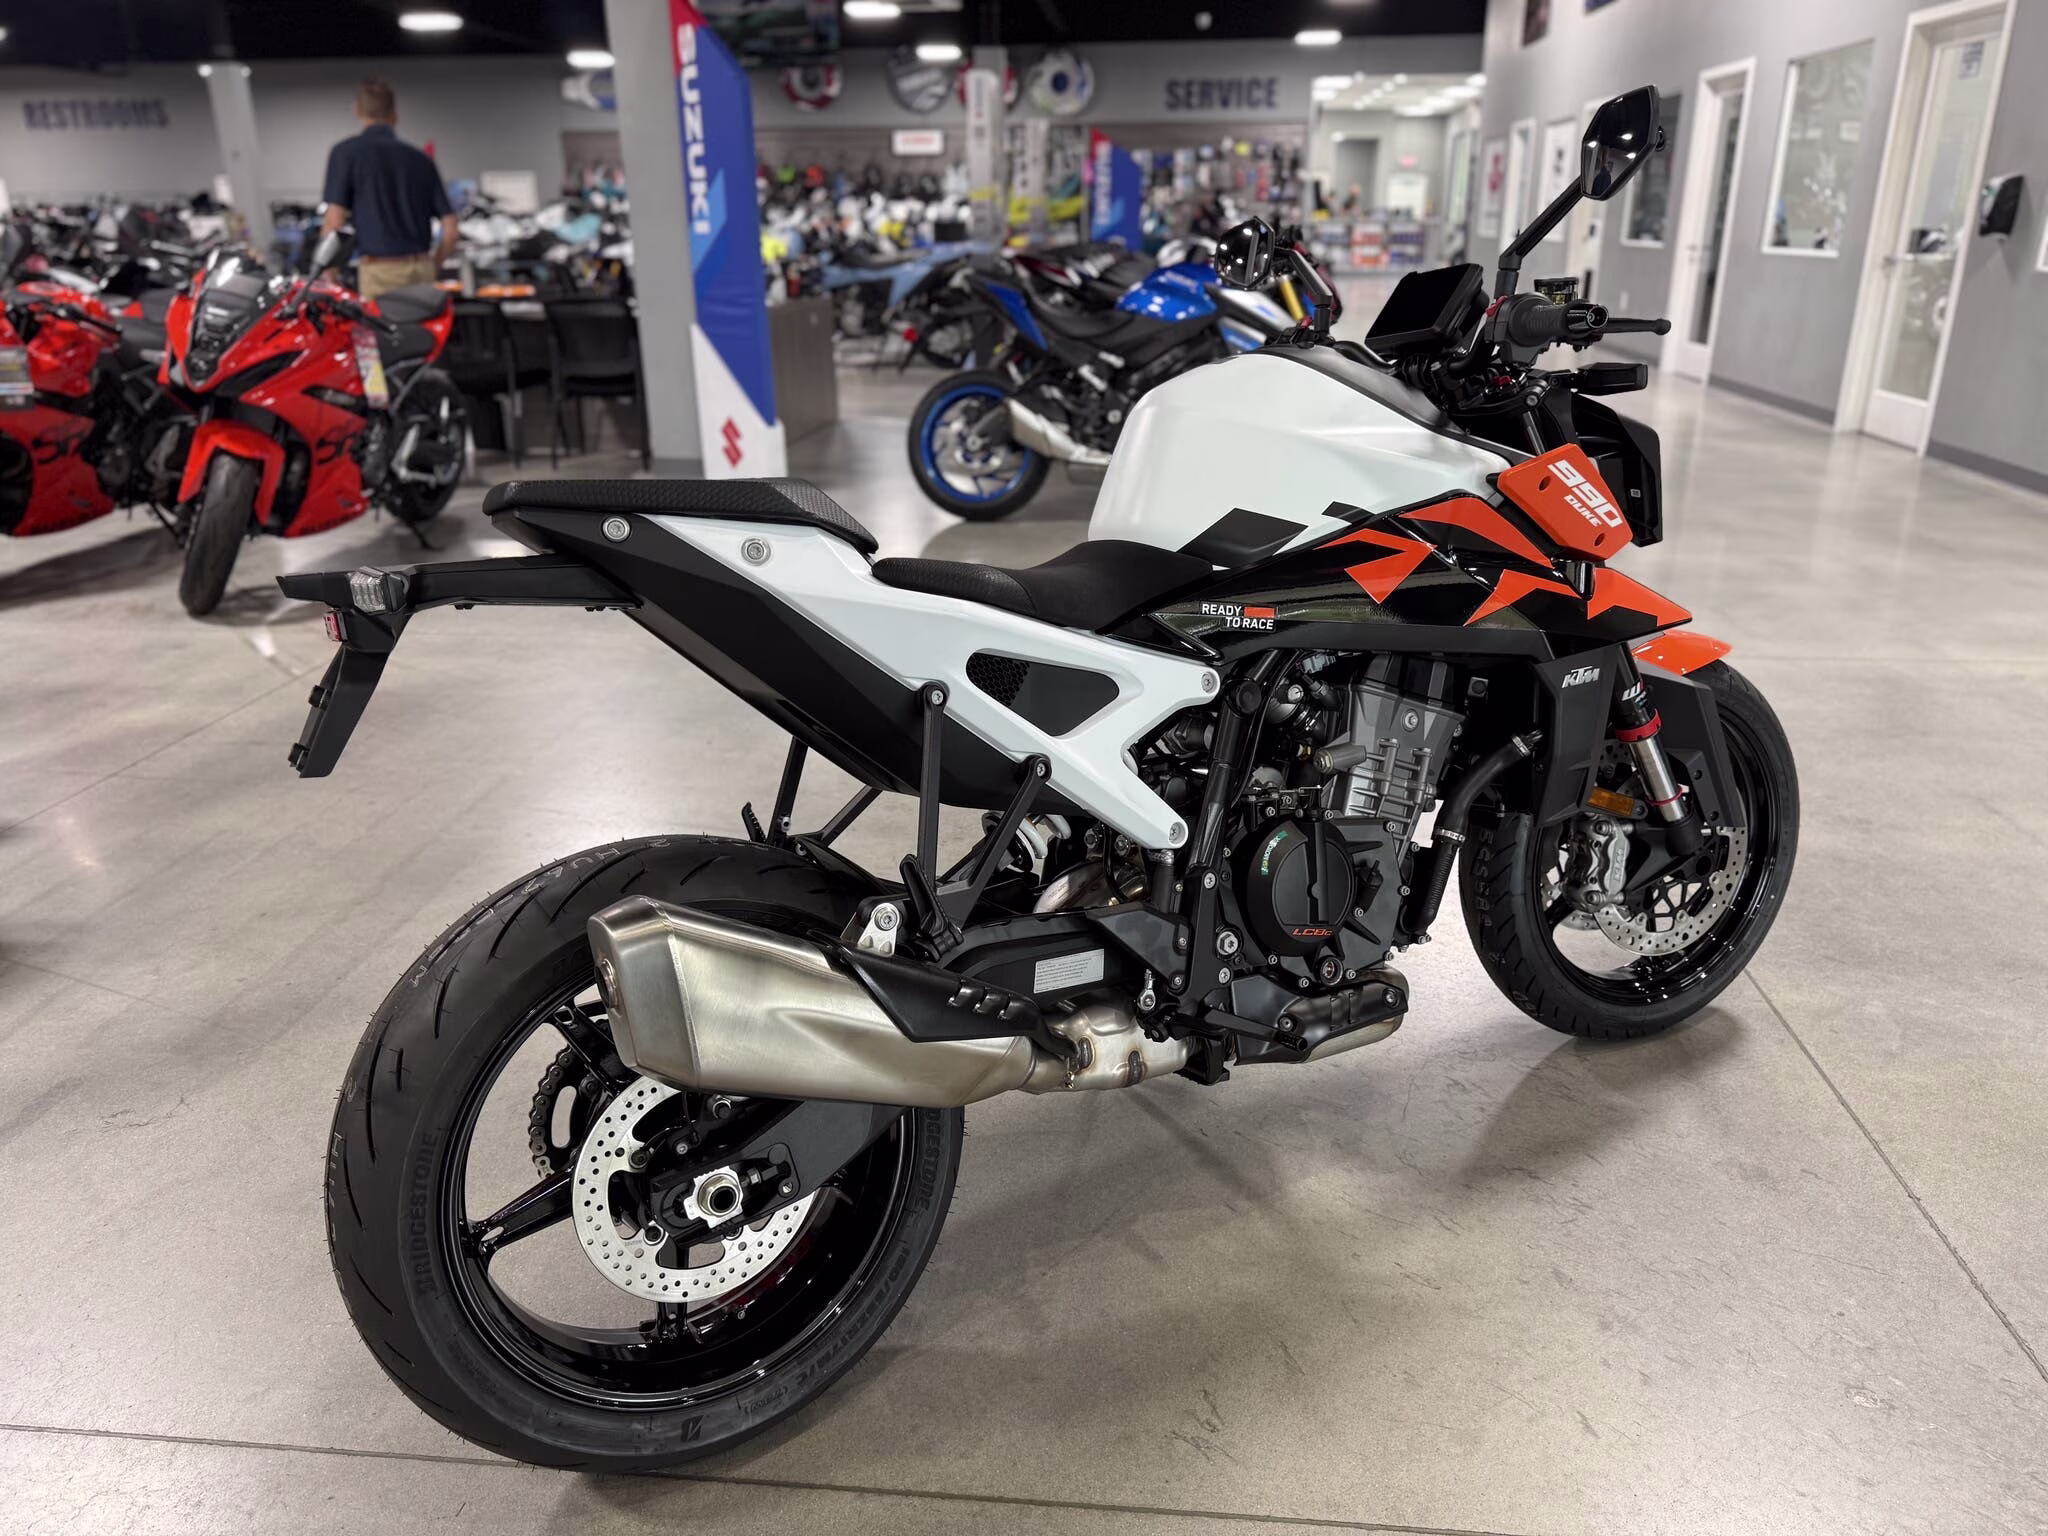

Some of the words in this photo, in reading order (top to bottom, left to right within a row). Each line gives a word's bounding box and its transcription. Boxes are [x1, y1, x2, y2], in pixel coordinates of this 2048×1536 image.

[1165, 77, 1280, 110] SERVICE
[23, 98, 170, 130] RESTROOMS
[677, 25, 712, 235] SUZUKI
[1547, 459, 1623, 528] 990
[1563, 494, 1602, 528] DUKE
[1202, 603, 1242, 616] READY
[1225, 616, 1241, 628] TO
[1242, 618, 1275, 630] RACE
[1562, 666, 1600, 688] KTM
[408, 1131, 438, 1292] BRIDGESTONE
